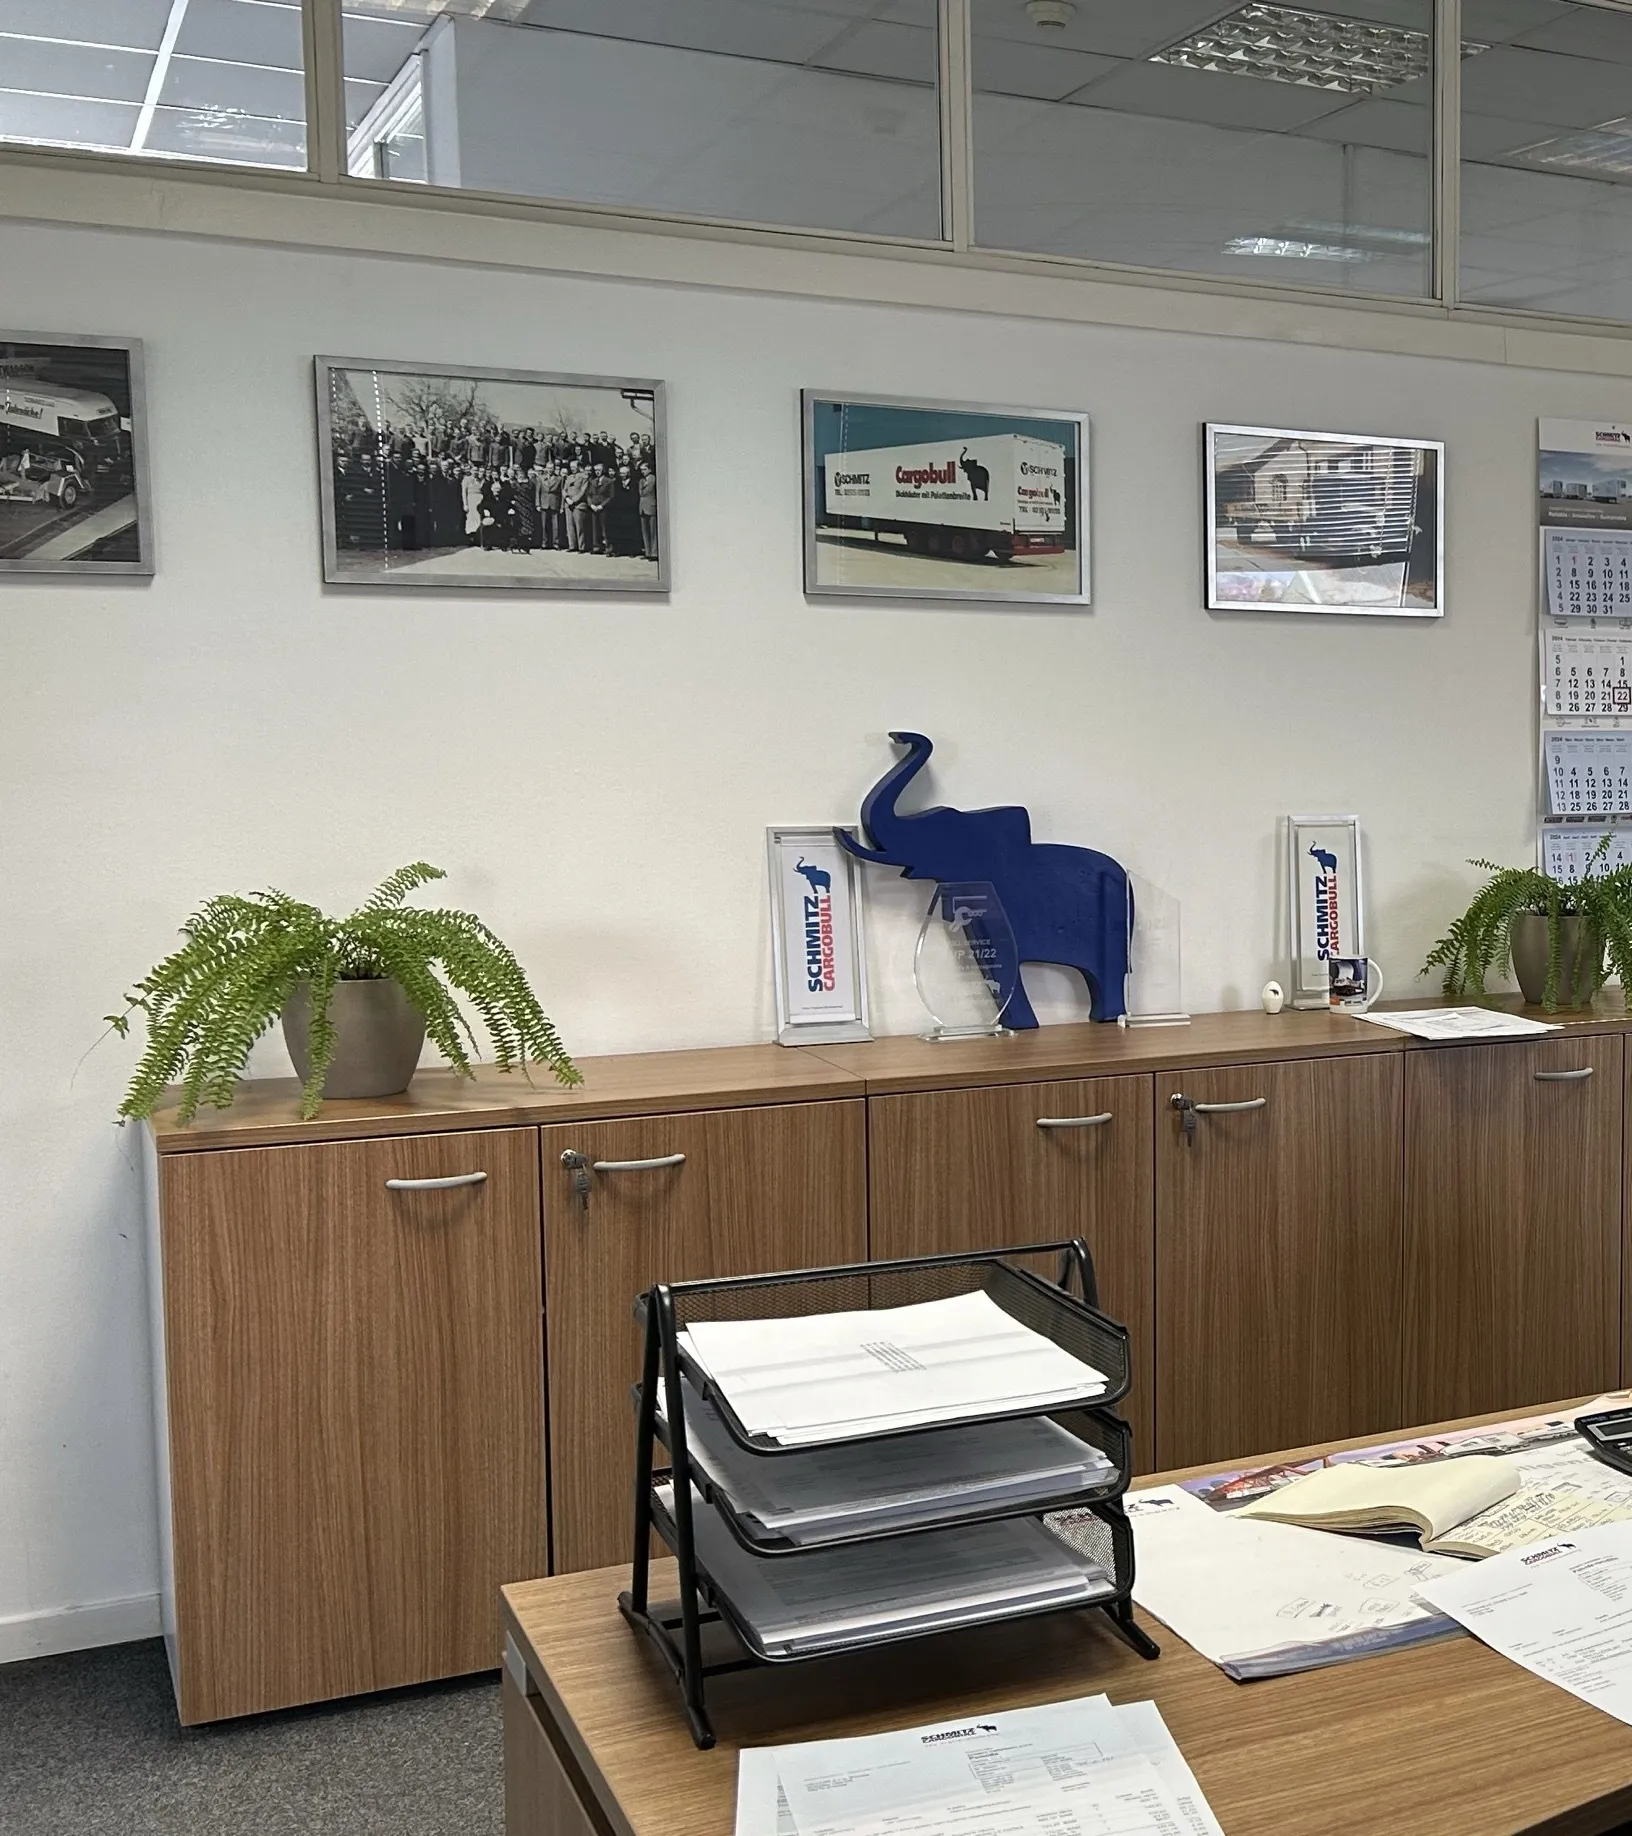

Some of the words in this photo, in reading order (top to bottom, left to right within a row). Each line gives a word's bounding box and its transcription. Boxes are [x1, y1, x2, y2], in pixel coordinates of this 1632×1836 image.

[842, 474, 870, 485] SCHMITZ
[896, 461, 956, 489] Cargobull
[1556, 556, 1560, 564] 1
[1572, 556, 1576, 565] 1
[1588, 557, 1593, 566] 2
[1605, 557, 1610, 566] 3
[1621, 558, 1626, 567] 4
[1556, 567, 1561, 576] 2
[1572, 568, 1576, 577] 8
[1588, 569, 1593, 578] 9
[1603, 569, 1613, 578] 10
[1620, 570, 1628, 579] 11
[1557, 580, 1562, 588] 3
[1570, 580, 1580, 589] 15
[1586, 580, 1596, 590] 16
[1603, 581, 1613, 590] 17
[1620, 582, 1629, 591] 18
[1558, 592, 1562, 600] 4
[1570, 592, 1580, 601] 22
[1586, 592, 1596, 602] 23
[1603, 593, 1613, 602] 24
[1620, 593, 1630, 602] 25
[1559, 603, 1564, 612] 5
[1570, 604, 1581, 613] 29
[1587, 604, 1597, 614] 30
[1603, 605, 1612, 614] 31
[1556, 655, 1560, 664] 5
[1621, 656, 1624, 665] 1
[1556, 667, 1561, 676] 6
[1571, 667, 1576, 676] 5
[1587, 668, 1592, 676] 6
[1604, 668, 1608, 676] 7
[1620, 668, 1625, 677] 8
[1556, 679, 1560, 687] 7
[1568, 679, 1578, 688] 12
[1585, 679, 1595, 688] 13
[1602, 680, 1611, 688] 14
[1556, 690, 1561, 700] 8
[1569, 691, 1579, 700] 19
[1585, 691, 1595, 700] 20
[1601, 692, 1610, 700] 21
[1618, 691, 1628, 700] 22
[1556, 703, 1561, 711] 9
[1569, 702, 1580, 712] 26
[1585, 703, 1596, 712] 27
[1602, 703, 1612, 712] 28
[1618, 704, 1628, 712] 29
[1555, 756, 1560, 764] 9
[1554, 767, 1563, 776] 10
[1571, 767, 1576, 776] 4
[1588, 767, 1592, 776] 5
[1604, 767, 1609, 776] 6
[1620, 766, 1625, 775] 7
[1555, 779, 1563, 788] 11
[1570, 779, 1578, 788] 11
[1586, 779, 1596, 788] 12
[1602, 778, 1612, 787] 13
[1618, 778, 1628, 787] 14
[1556, 791, 1565, 800] 12
[1570, 791, 1580, 799] 18
[1586, 790, 1596, 799] 19
[1602, 790, 1612, 799] 20
[1618, 790, 1627, 798] 21
[1557, 802, 1566, 812] 13
[1570, 802, 1581, 811] 25
[1587, 802, 1597, 811] 26
[1603, 802, 1613, 810] 27
[1619, 801, 1629, 810] 28
[1552, 853, 1562, 862] 14
[1570, 853, 1574, 862] 1
[1585, 852, 1590, 861] 2
[1602, 852, 1606, 860] 3
[1618, 852, 1622, 860] 4
[1553, 865, 1562, 874] 15
[1570, 864, 1574, 873] 8
[1600, 864, 1610, 872] 10
[1316, 876, 1330, 961] SCHMITZ
[1328, 875, 1339, 956] ARGOBULL
[804, 896, 824, 992] SCHMITZ
[820, 895, 835, 992] CARGOBULL
[968, 948, 997, 959] 21/22
